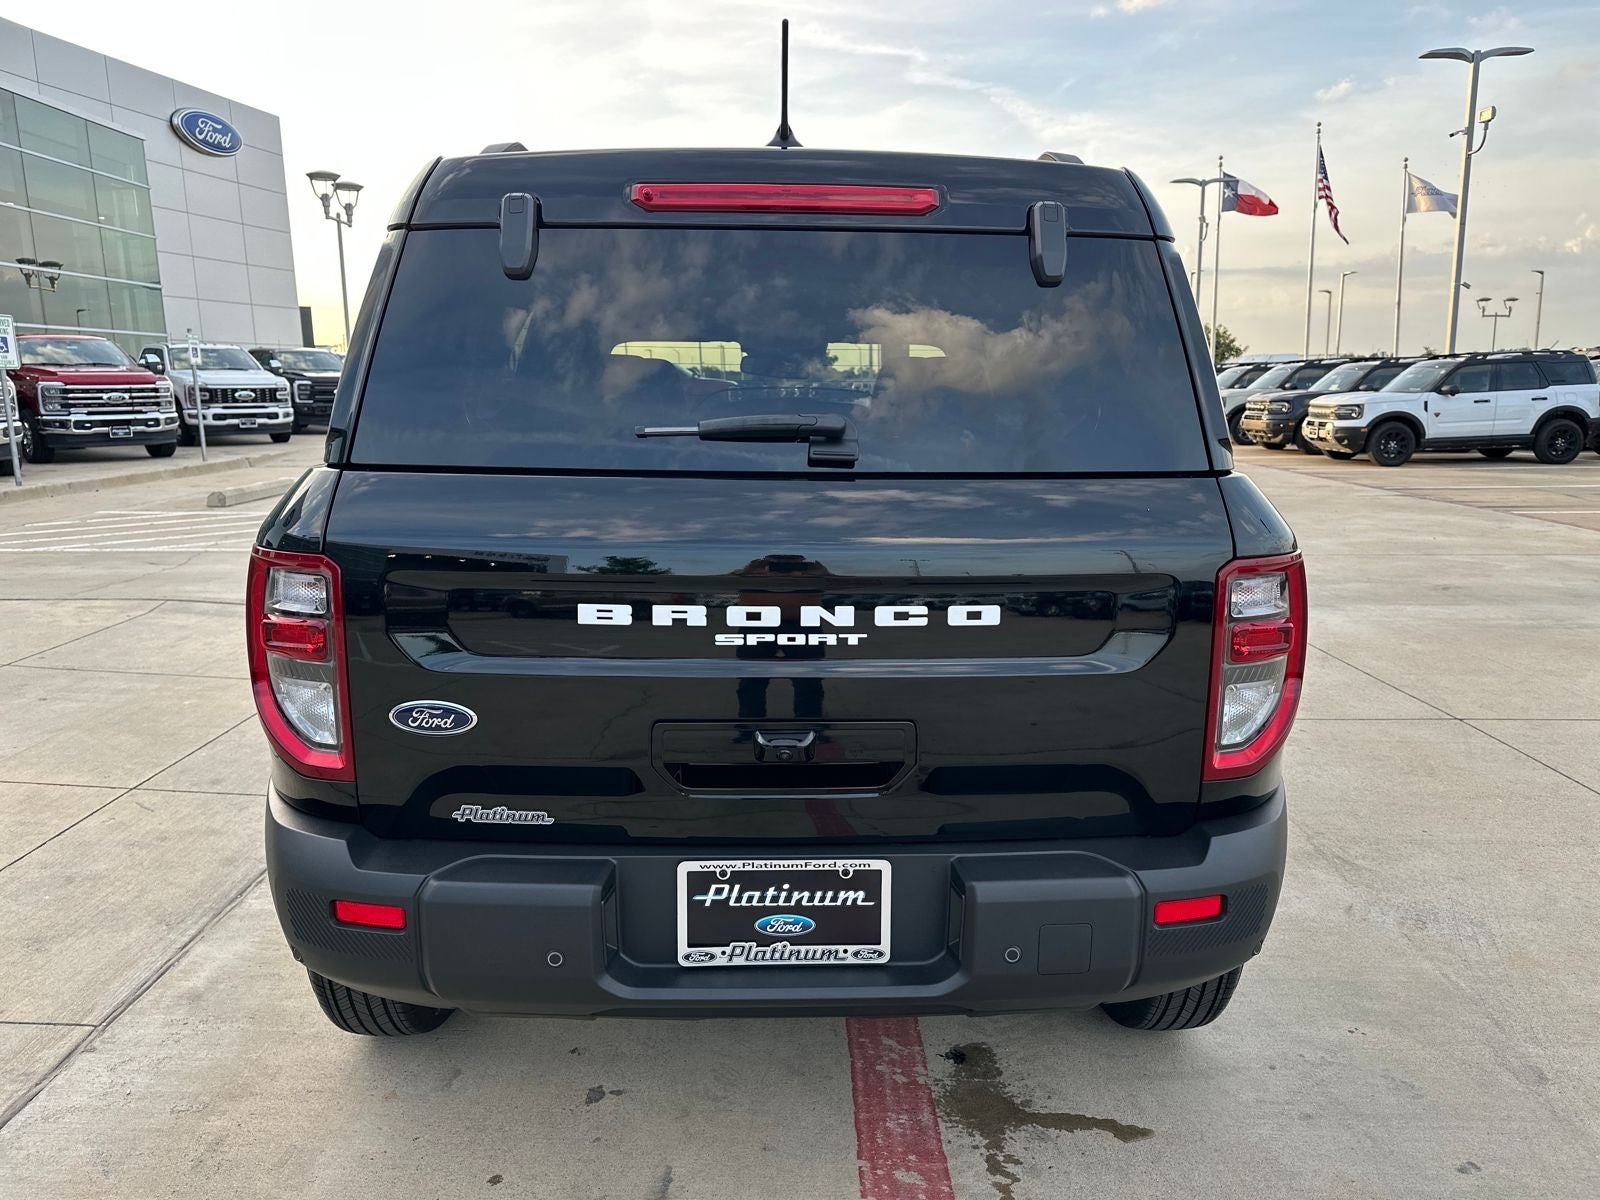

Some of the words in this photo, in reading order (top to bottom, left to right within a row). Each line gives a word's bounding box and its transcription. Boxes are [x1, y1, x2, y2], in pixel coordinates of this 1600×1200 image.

[195, 117, 232, 148] Ford
[577, 603, 1001, 627] BRONCO
[714, 633, 868, 646] SPORT
[408, 707, 455, 728] Ford
[452, 805, 554, 824] Platinum
[699, 861, 871, 870] www.PlatinumFord.com
[692, 883, 875, 907] Platinum
[766, 917, 804, 933] Ford
[688, 951, 712, 961] Ford
[720, 942, 849, 963] Platinum
[857, 949, 880, 959] Ford
